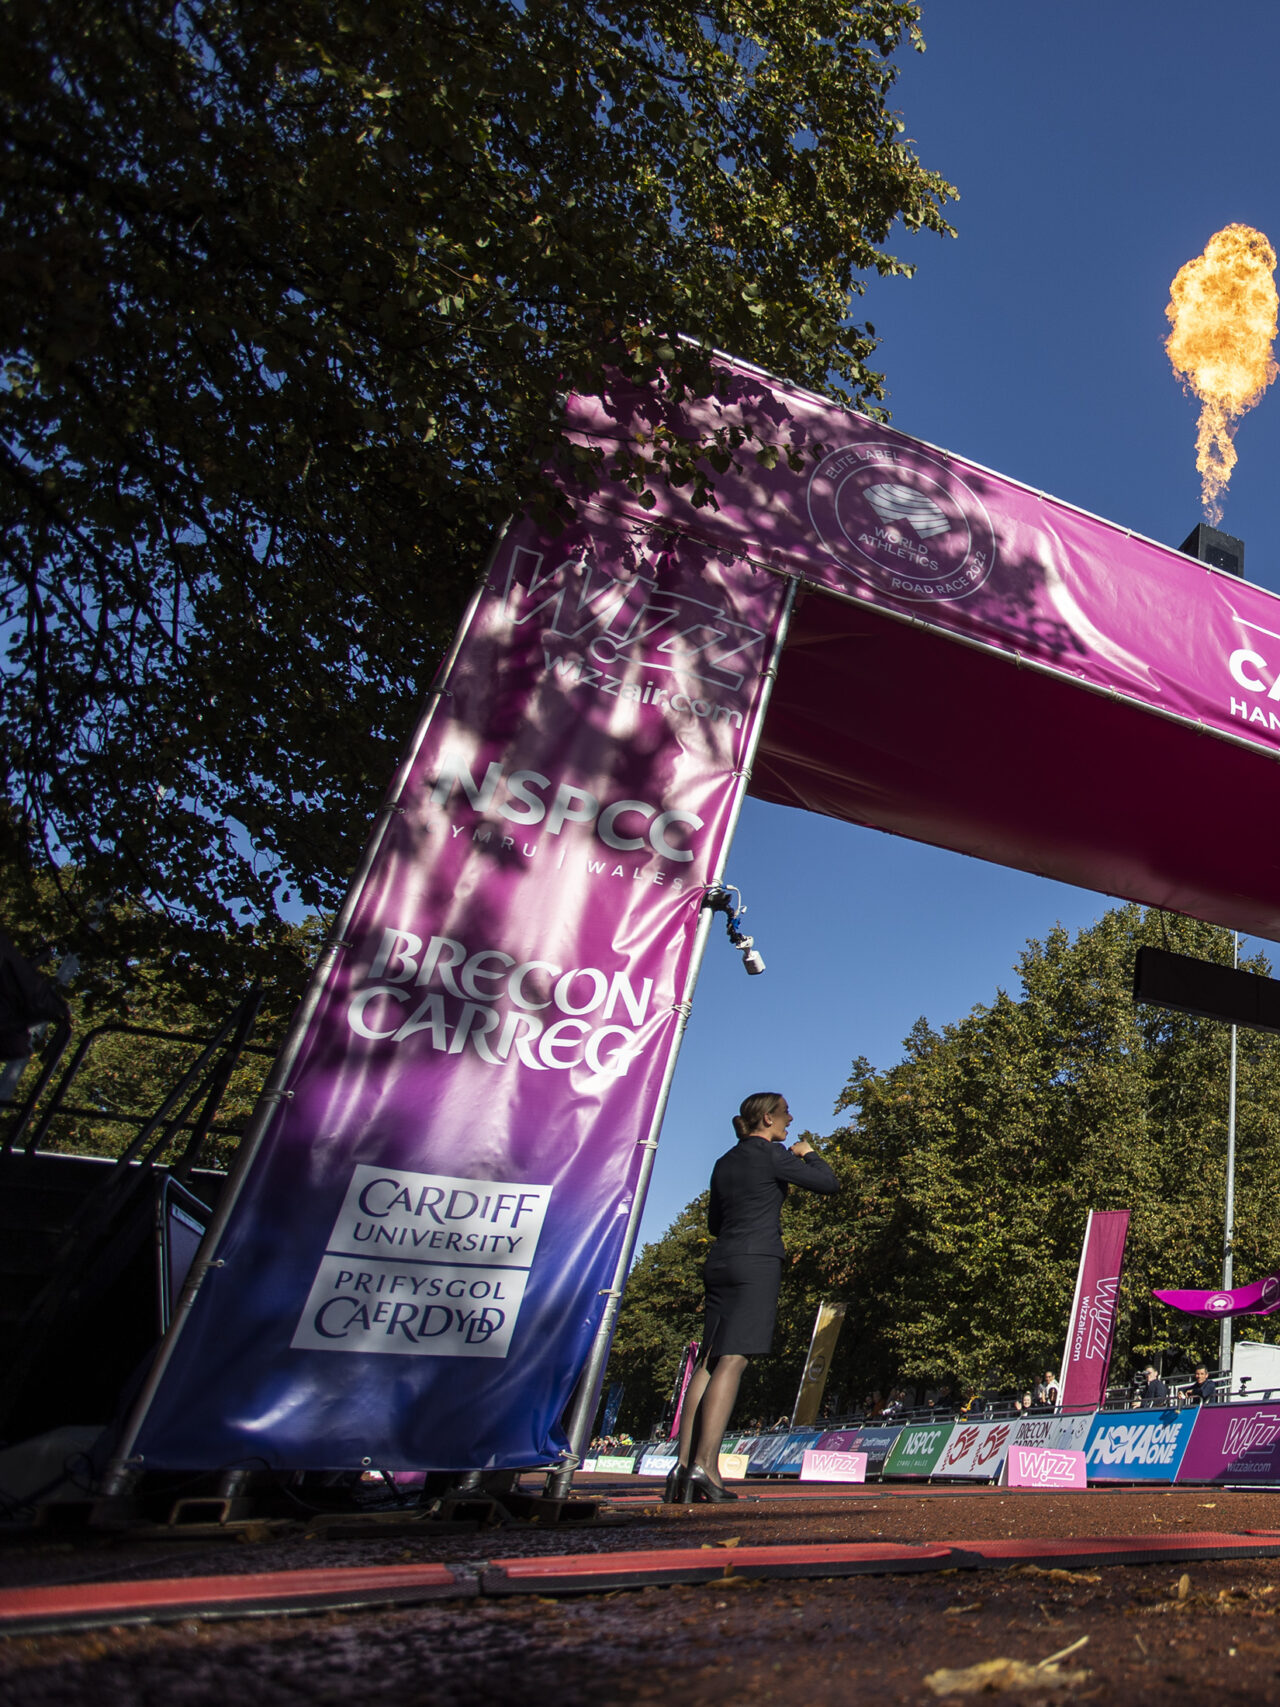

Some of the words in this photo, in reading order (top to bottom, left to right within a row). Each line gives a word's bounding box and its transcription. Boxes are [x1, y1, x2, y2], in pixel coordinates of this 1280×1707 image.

[825, 453, 857, 479] ELITE
[856, 450, 902, 462] LABEL
[858, 533, 939, 571] ATHLETICS
[874, 527, 928, 555] WORLD
[891, 577, 934, 594] ROAD
[936, 576, 969, 594] RACE
[966, 550, 987, 581] 2022
[543, 650, 743, 730] wizzair.com
[430, 754, 705, 863] NSPCC
[425, 820, 538, 858] CYMRU
[587, 860, 684, 891] WALES
[367, 927, 653, 1026] BRECON
[347, 985, 644, 1078] CARREG
[358, 1178, 540, 1229] CARDIFF
[352, 1222, 523, 1254] UNIVERSITY
[334, 1271, 506, 1300] PRIFYSGOL
[313, 1296, 506, 1345] CAERDYDD
[1072, 1295, 1090, 1362] wizzair.com
[903, 1430, 941, 1455] NSPCC
[1017, 1421, 1052, 1439] BRECON
[1086, 1425, 1155, 1464] HOKA
[1151, 1423, 1182, 1444] ONE
[598, 1458, 631, 1468] NSPCC
[1146, 1443, 1177, 1464] ONE
[1227, 1460, 1271, 1472] wizzair.com
